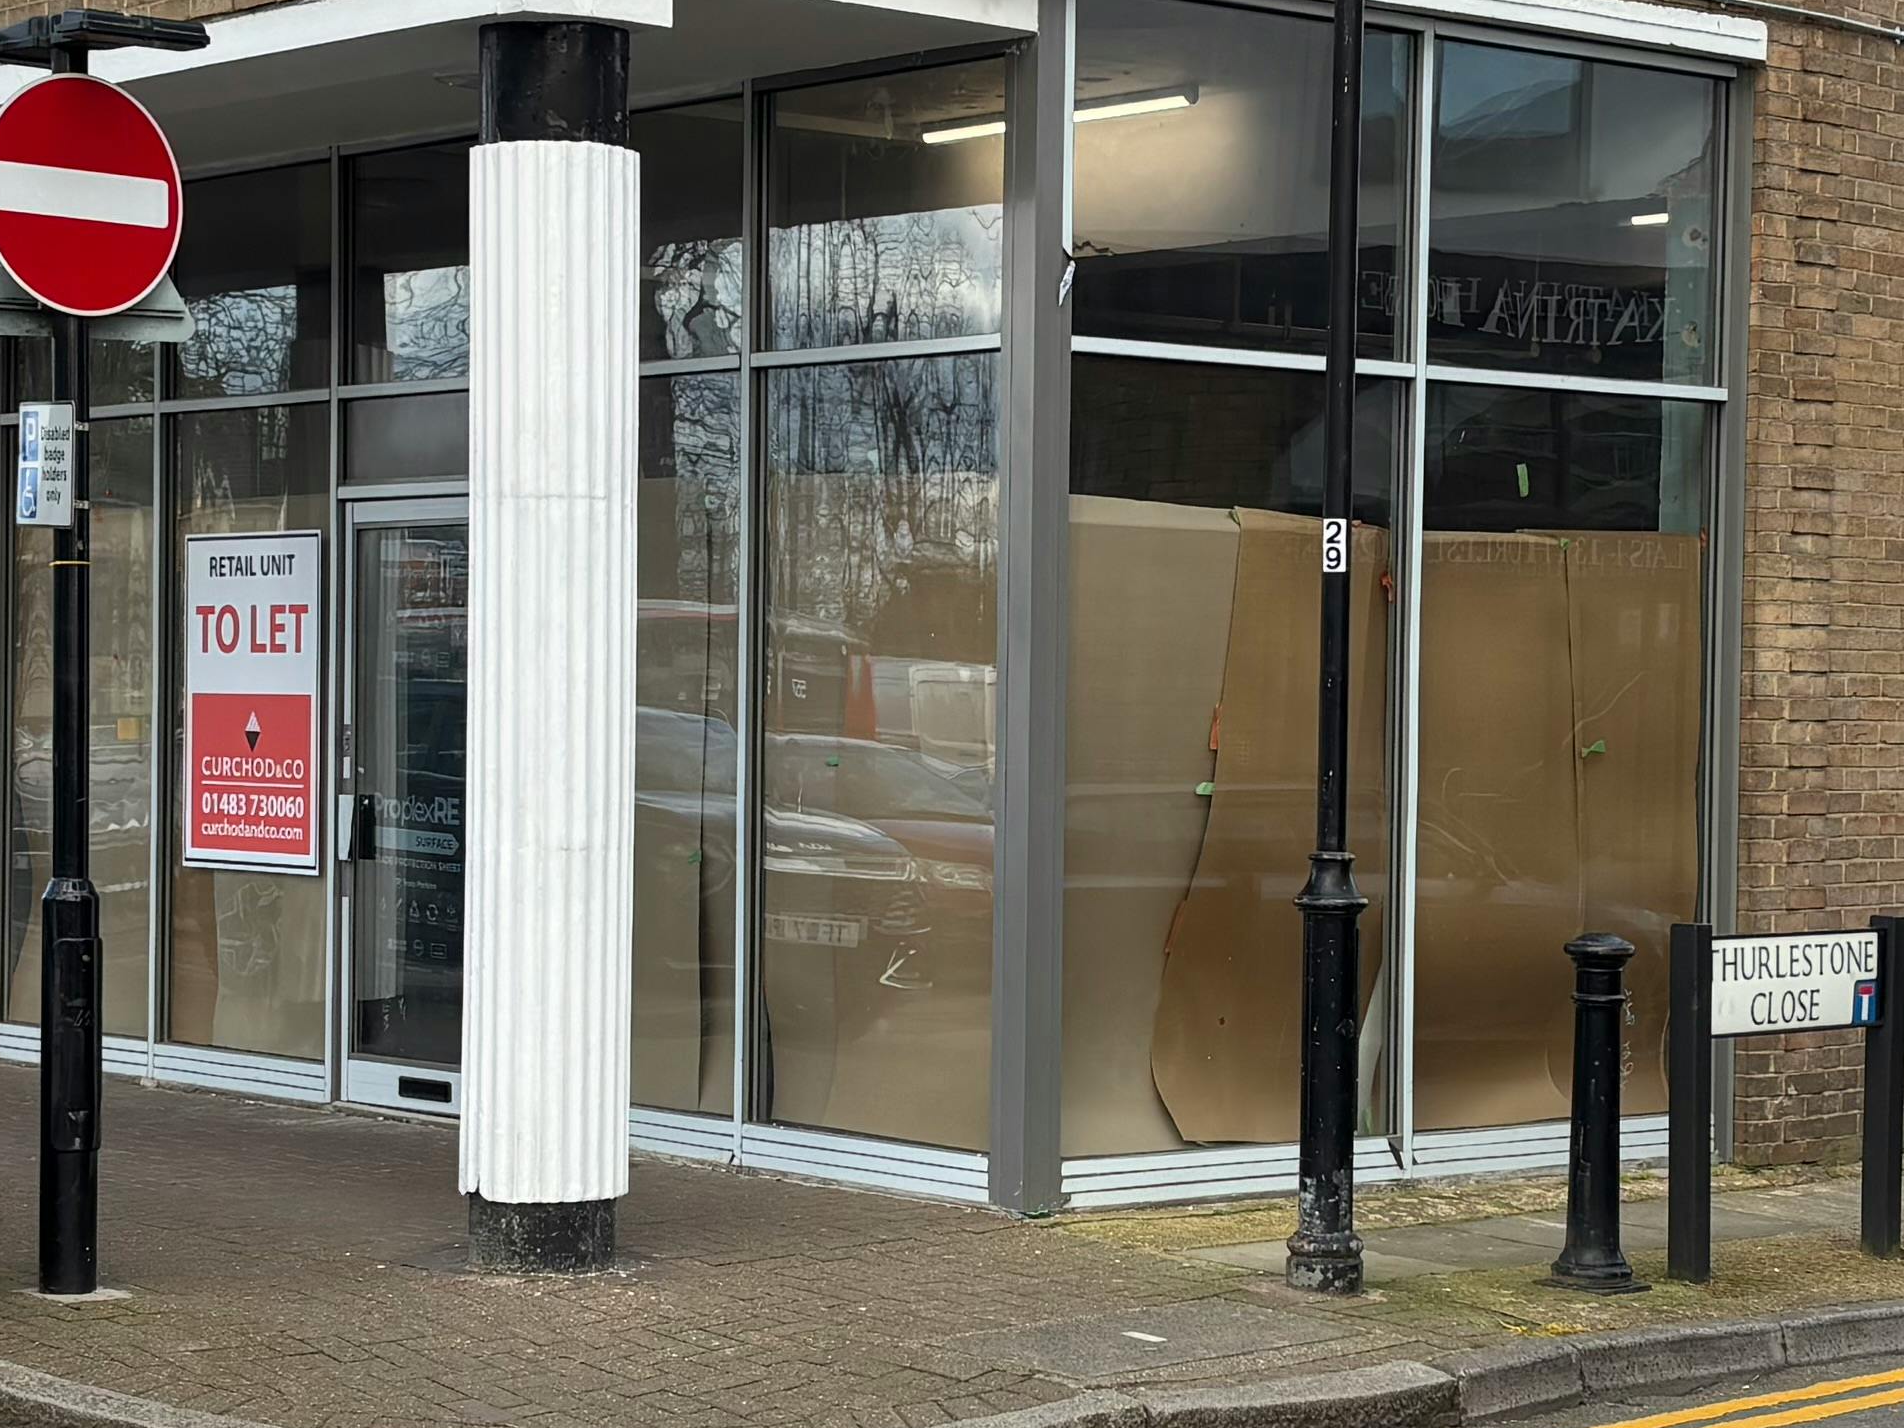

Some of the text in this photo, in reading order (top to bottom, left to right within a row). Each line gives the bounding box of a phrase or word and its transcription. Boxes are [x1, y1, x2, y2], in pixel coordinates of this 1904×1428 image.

[40, 426, 71, 442] Disabled
[44, 446, 65, 464] badge
[41, 466, 67, 482] holders
[46, 487, 61, 506] only
[209, 553, 296, 578] RETAIL UNIT
[196, 603, 310, 655] TO LET
[201, 755, 305, 779] CURCHOD&CO
[201, 792, 305, 819] 01483 730060
[201, 818, 303, 841] curchodandco.com
[1750, 988, 1821, 1026] CLOSE
